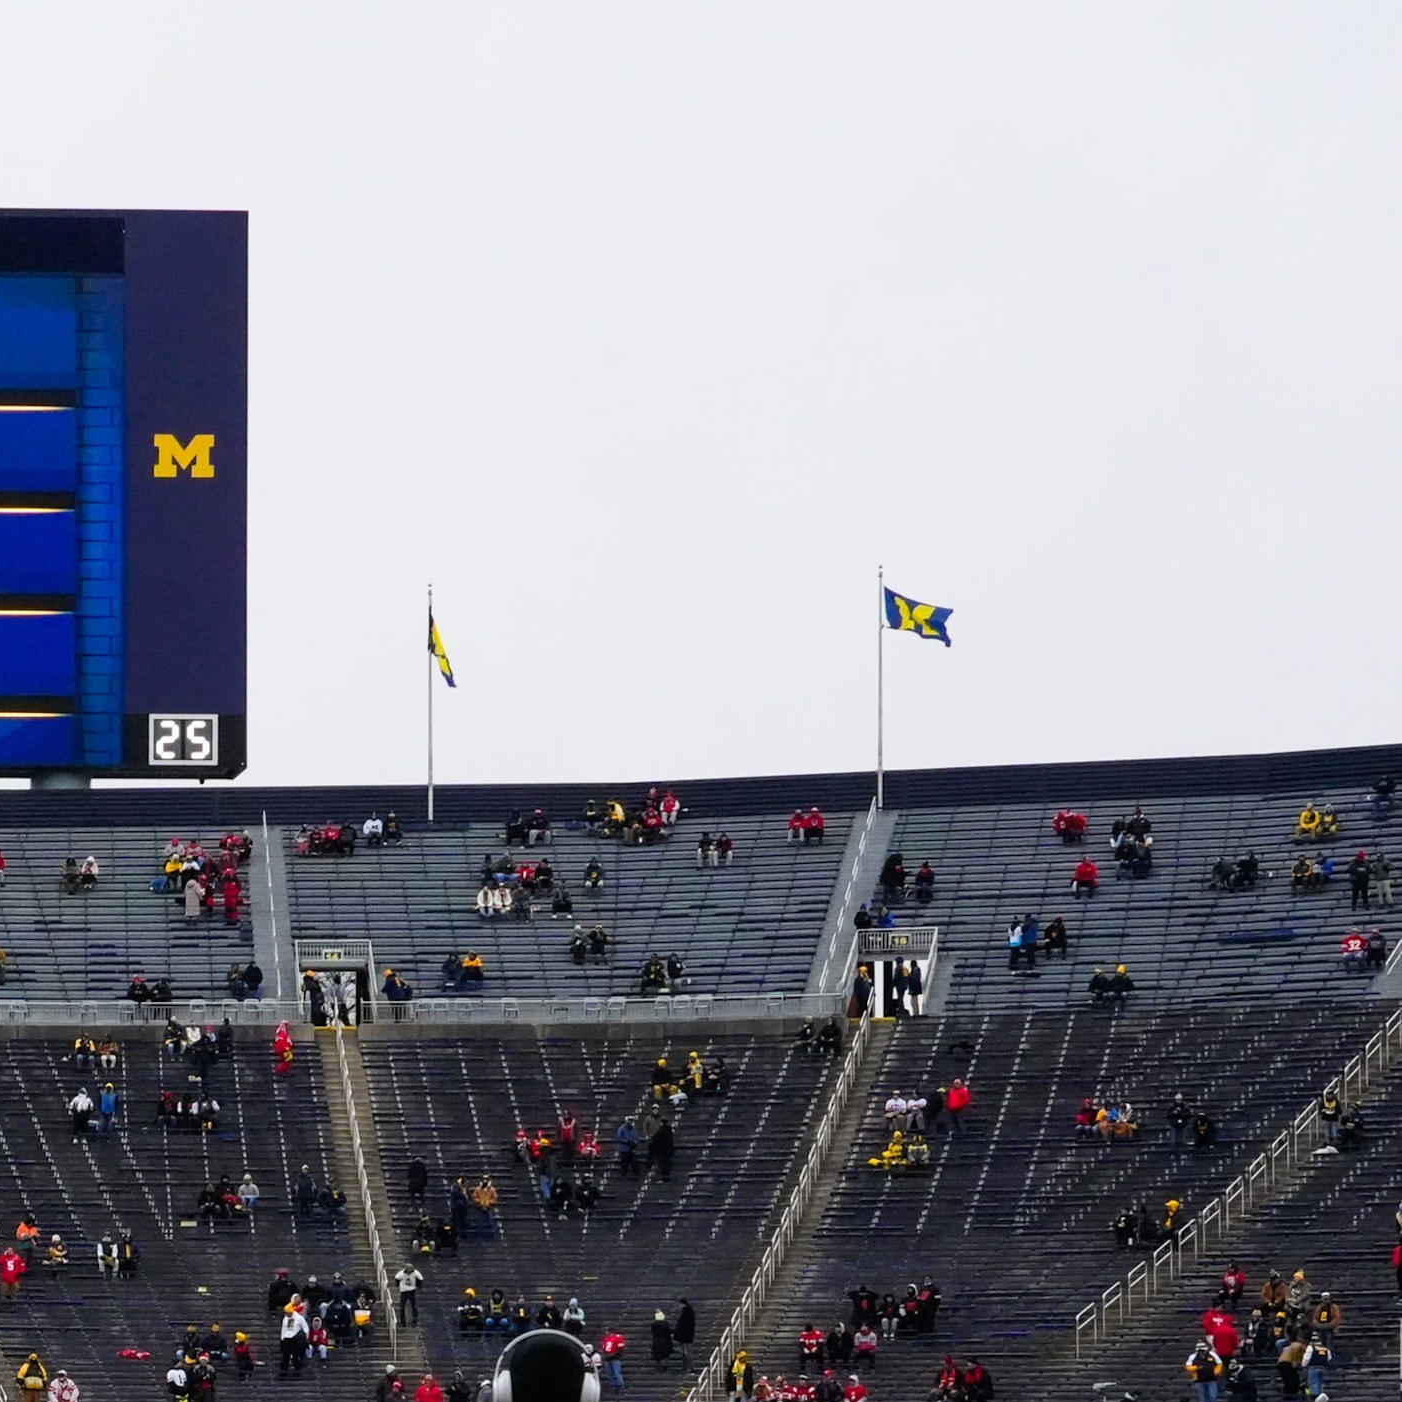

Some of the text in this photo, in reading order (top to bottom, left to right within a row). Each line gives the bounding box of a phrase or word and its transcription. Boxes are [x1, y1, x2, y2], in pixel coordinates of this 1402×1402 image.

[153, 433, 216, 478] M
[155, 719, 210, 760] 25
[1348, 939, 1361, 950] 32
[6, 1260, 14, 1271] 5
